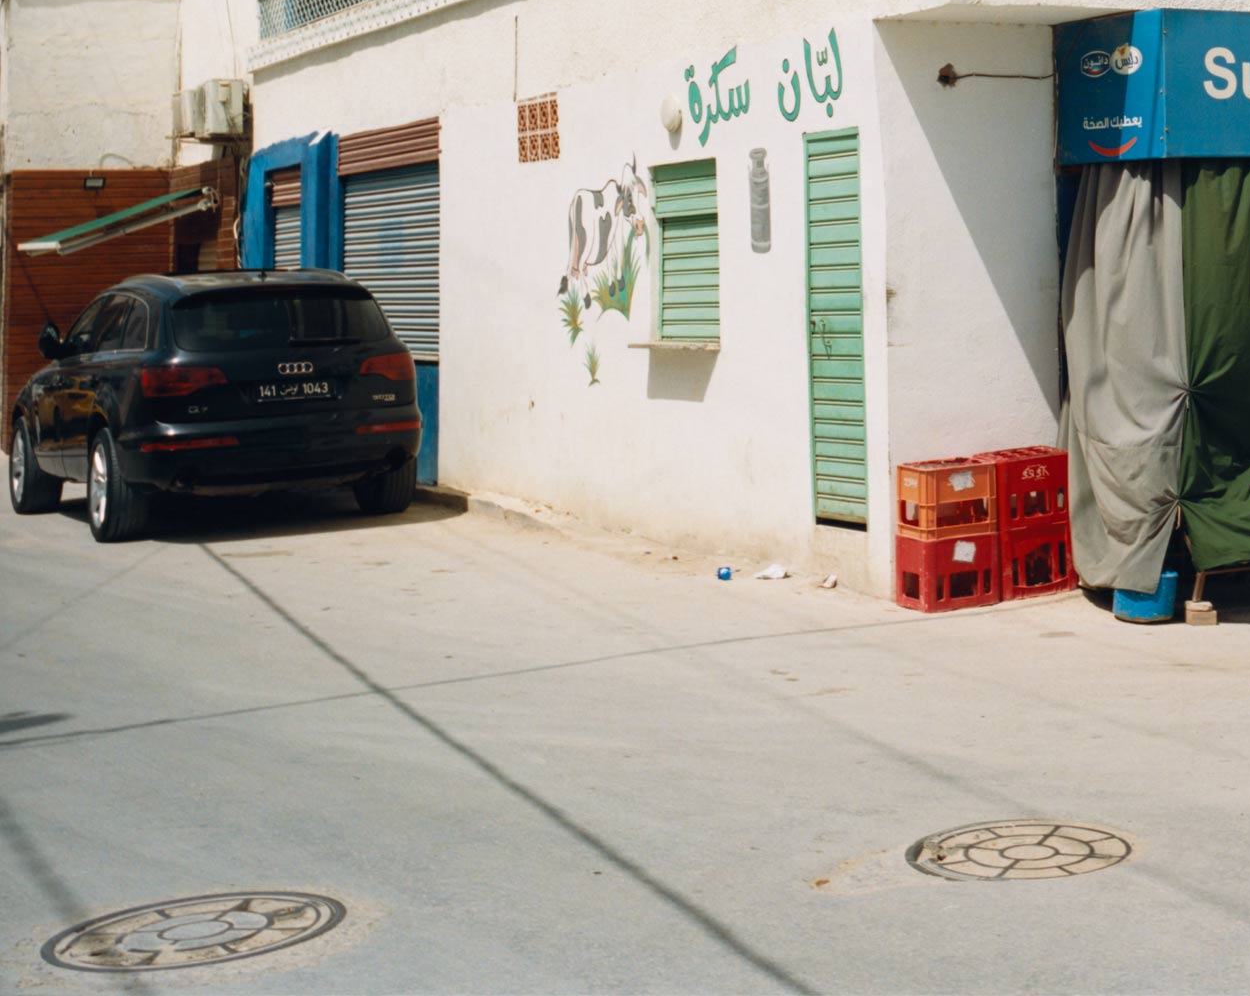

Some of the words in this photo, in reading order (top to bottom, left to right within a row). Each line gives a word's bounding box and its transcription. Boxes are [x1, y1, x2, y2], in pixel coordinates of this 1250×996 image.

[1110, 115, 1143, 130] يعطيك
[259, 385, 276, 397] 141
[302, 381, 329, 394] 1043
